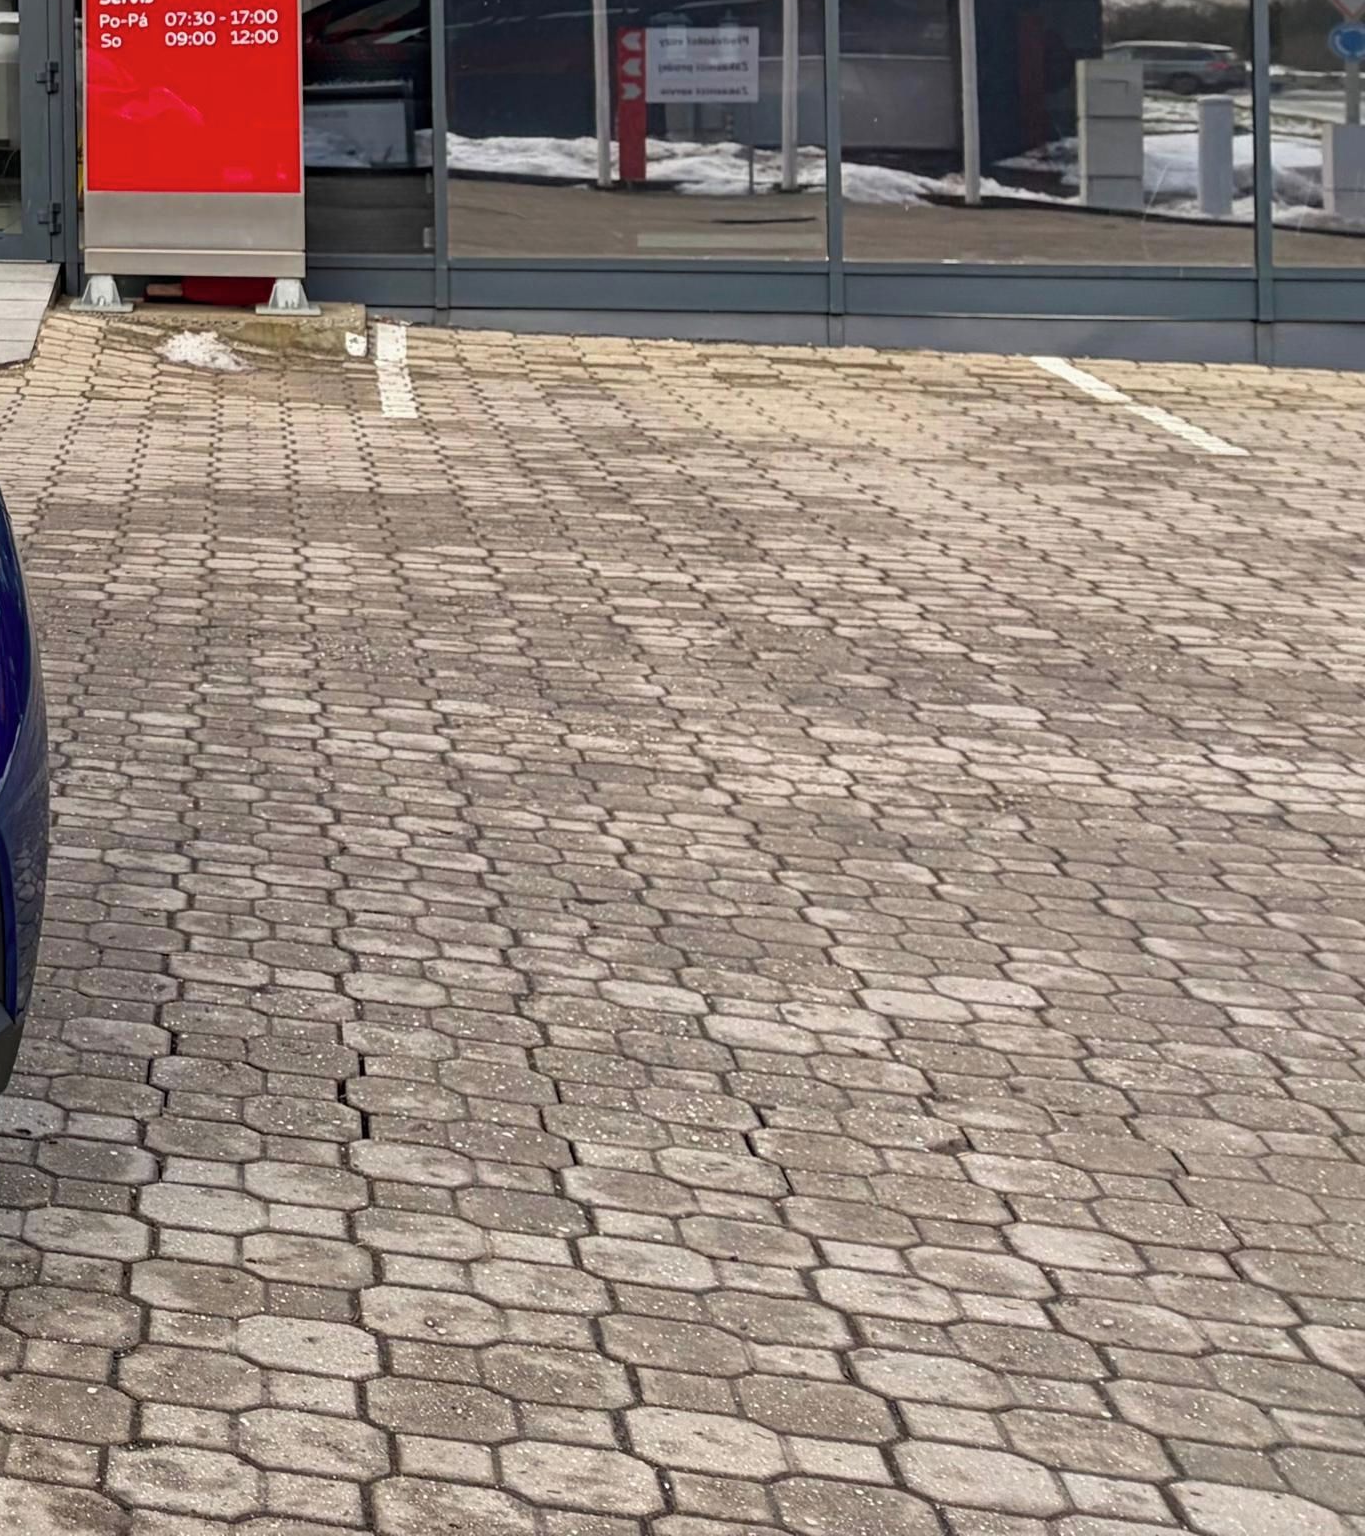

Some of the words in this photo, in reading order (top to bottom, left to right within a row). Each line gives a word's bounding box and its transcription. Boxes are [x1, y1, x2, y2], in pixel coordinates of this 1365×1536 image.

[99, 12, 148, 28] Po-Pá
[164, 11, 216, 27] 07:30
[230, 9, 278, 24] 17:00
[101, 33, 122, 48] So
[165, 31, 216, 46] 09:00
[230, 29, 279, 45] 12:00
